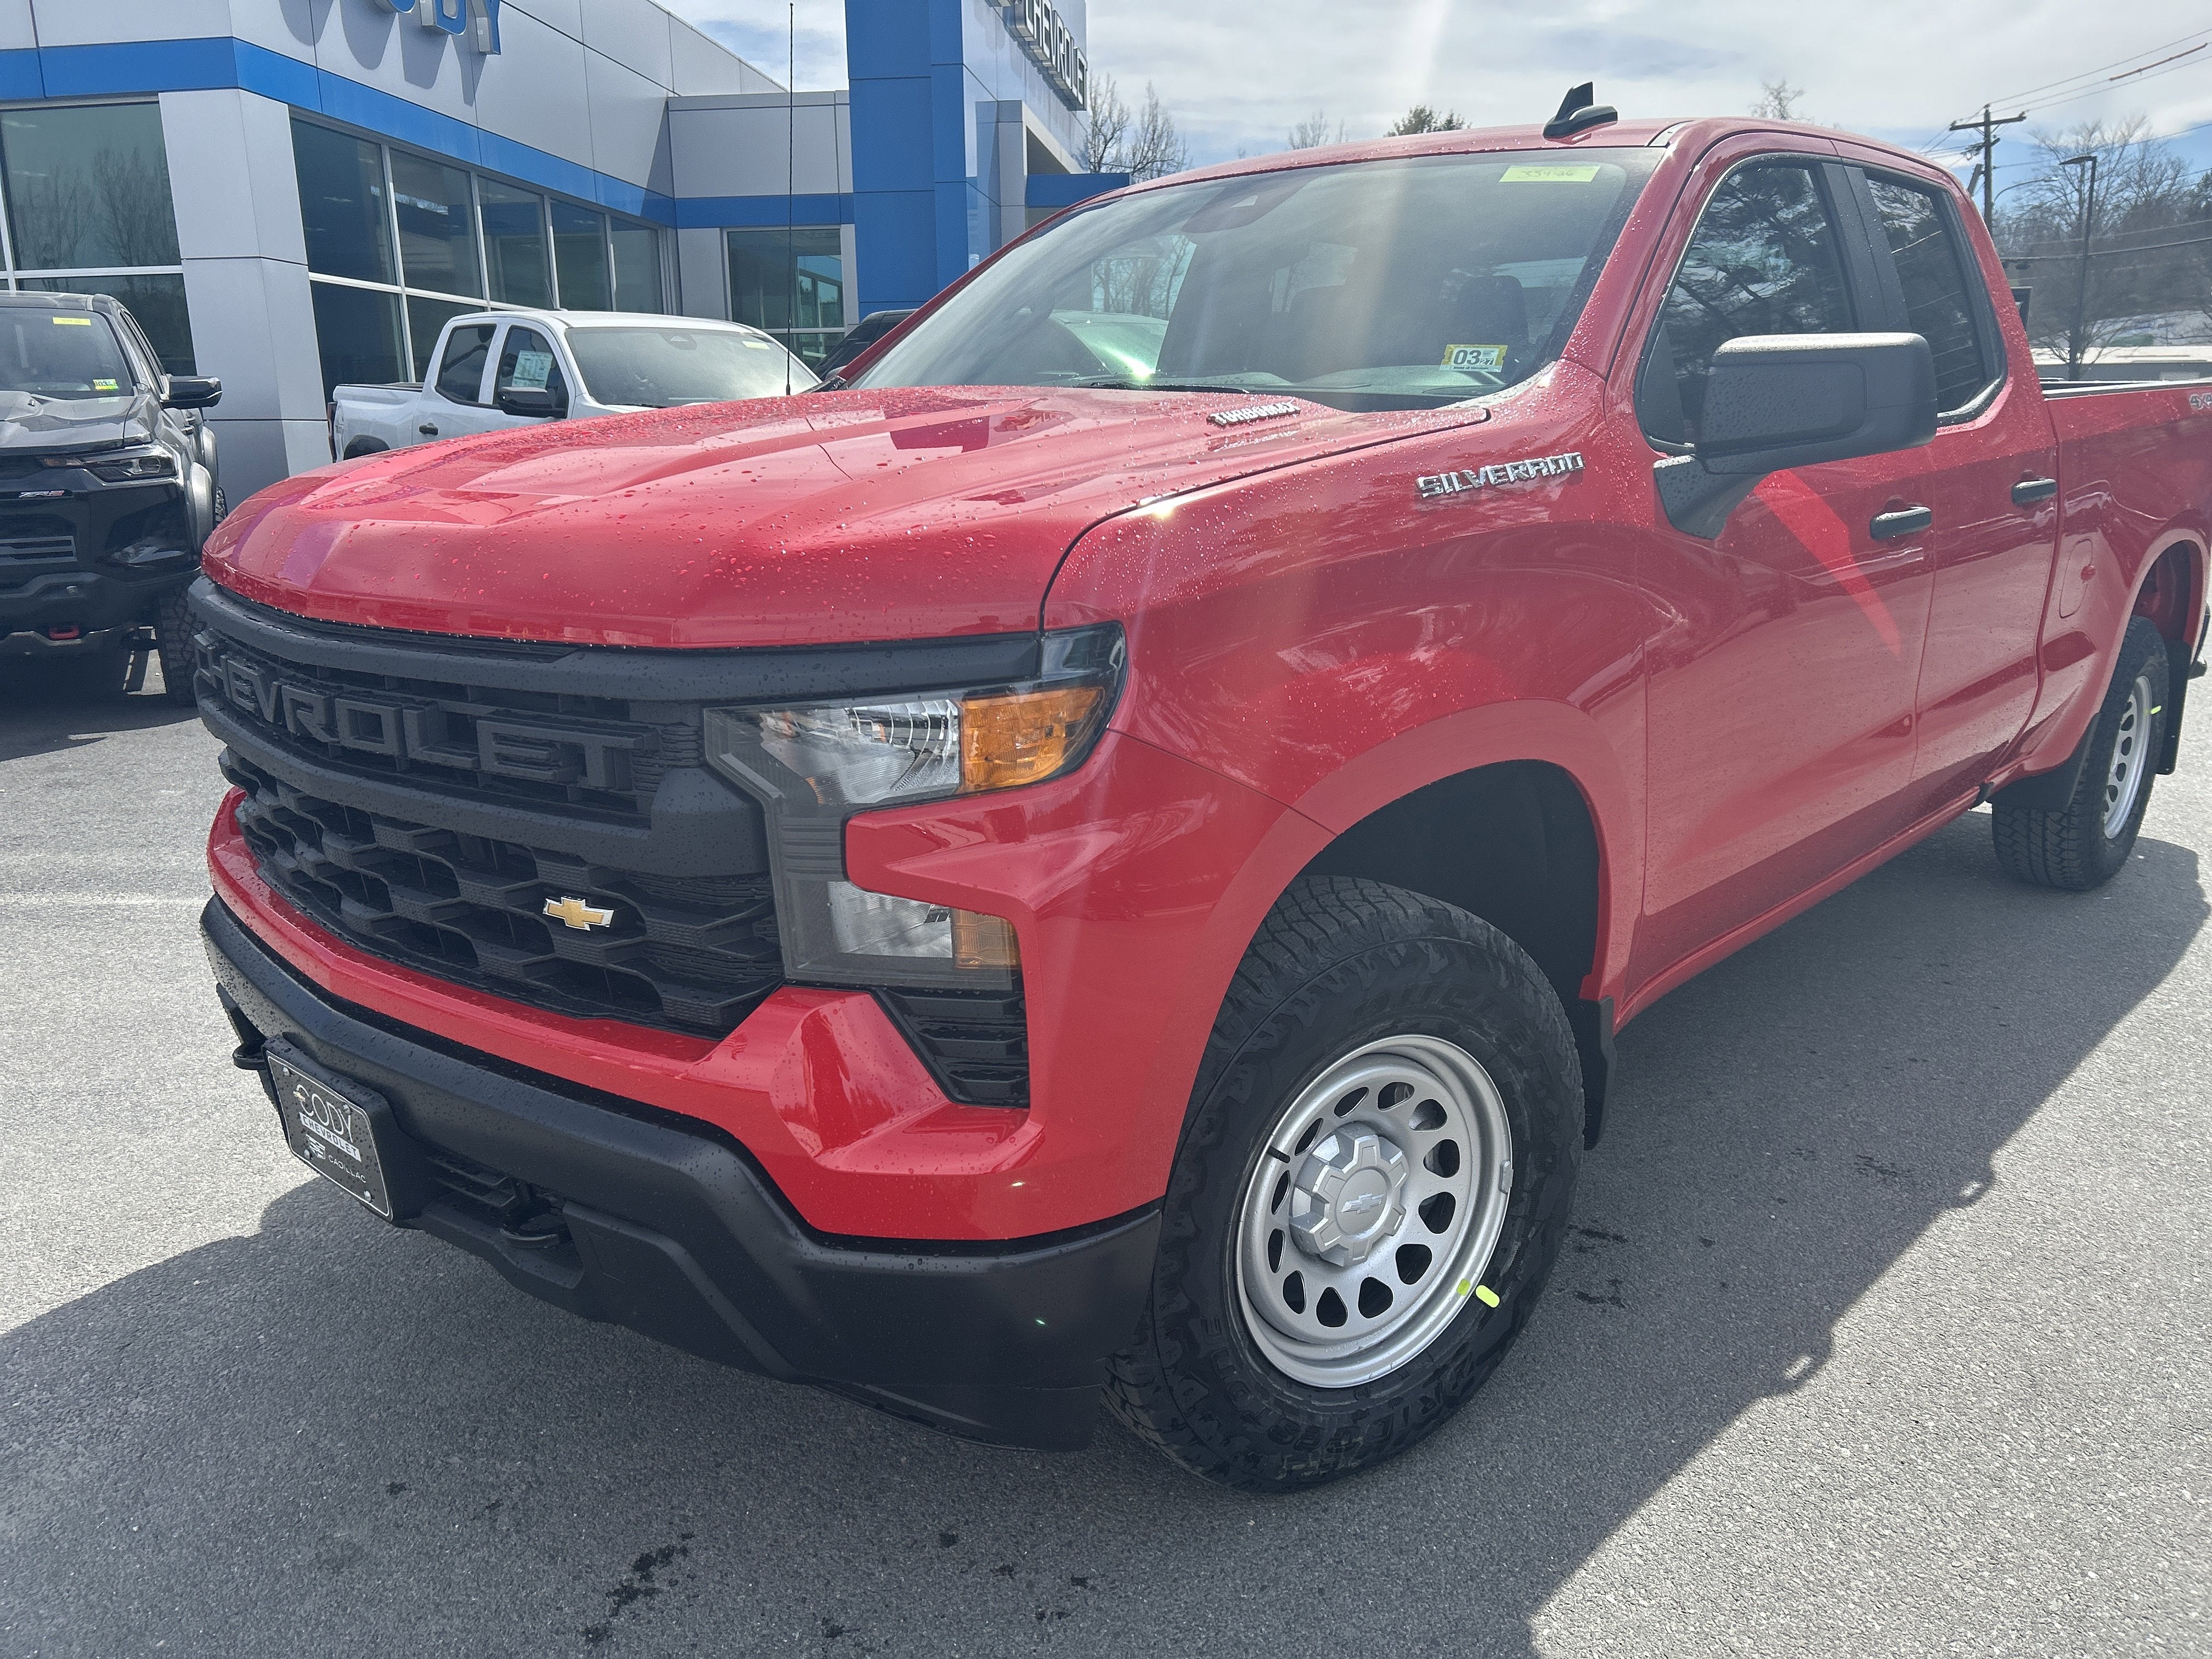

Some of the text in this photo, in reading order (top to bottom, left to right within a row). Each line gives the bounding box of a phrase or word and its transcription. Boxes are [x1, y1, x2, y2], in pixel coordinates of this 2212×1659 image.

[1454, 349, 1481, 365] 03
[1416, 452, 1585, 498] SILVERADO
[194, 631, 658, 791] HEVROLET
[293, 1084, 353, 1143] CODY
[302, 1115, 358, 1159] CHEVROLET
[328, 1155, 366, 1183] CADILLAC
